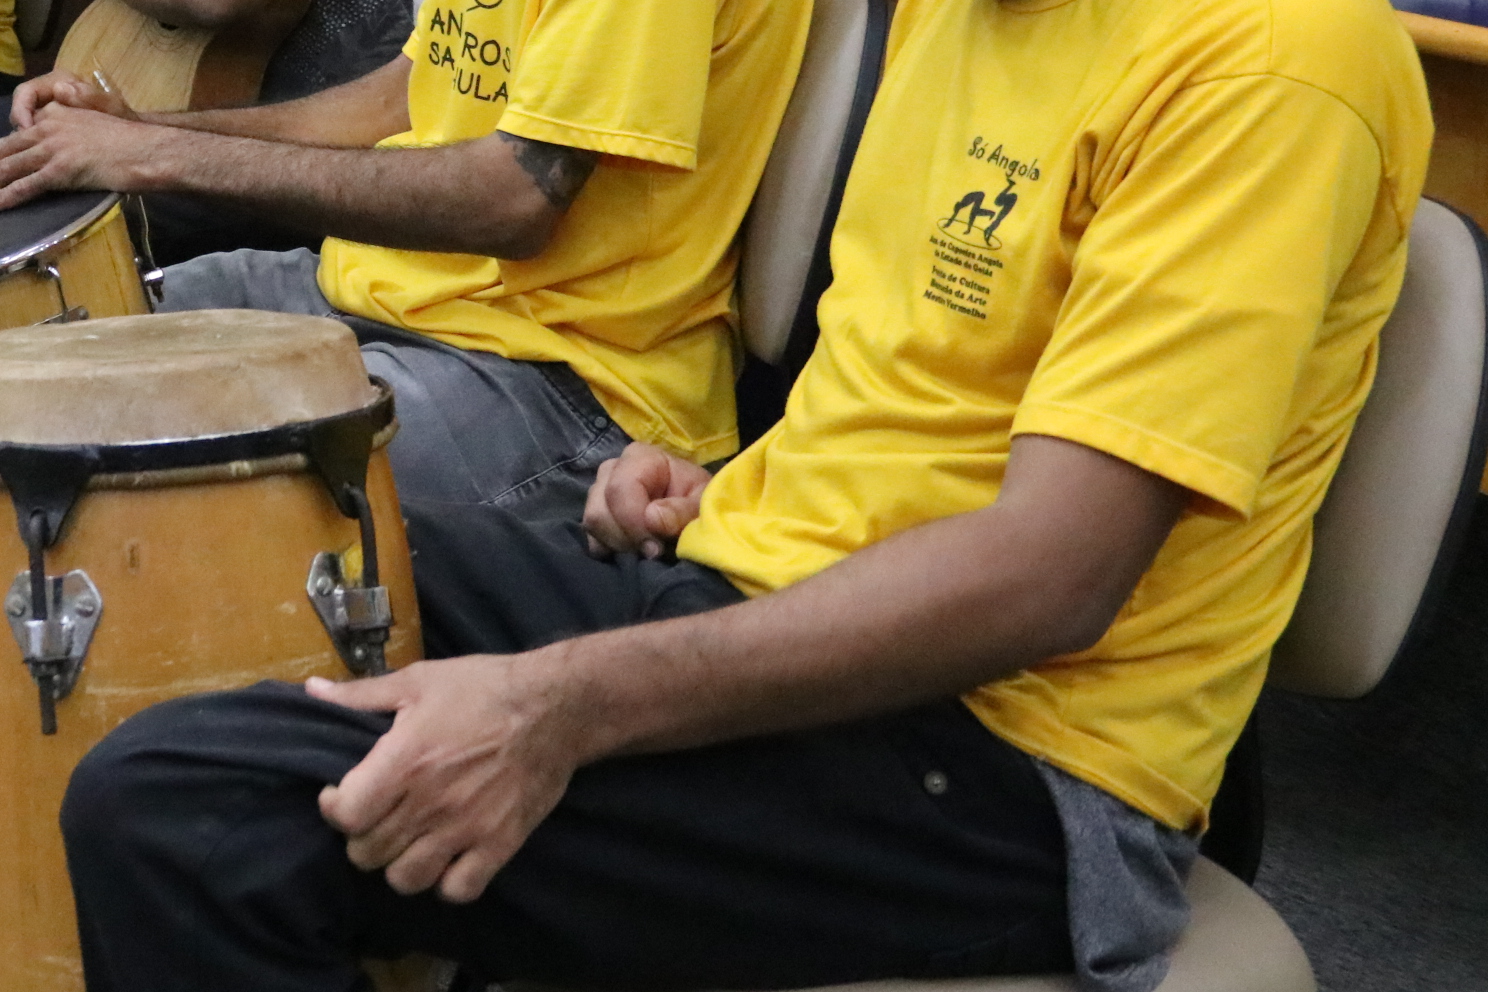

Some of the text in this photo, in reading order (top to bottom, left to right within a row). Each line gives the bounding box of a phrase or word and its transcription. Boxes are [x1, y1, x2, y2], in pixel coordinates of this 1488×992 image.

[454, 67, 509, 104] ULA
[968, 136, 1041, 181] Só Angola
[977, 254, 1004, 268] Angola
[959, 277, 990, 294] Cultura
[946, 298, 986, 320] Vermelho
[966, 294, 987, 306] Arte
